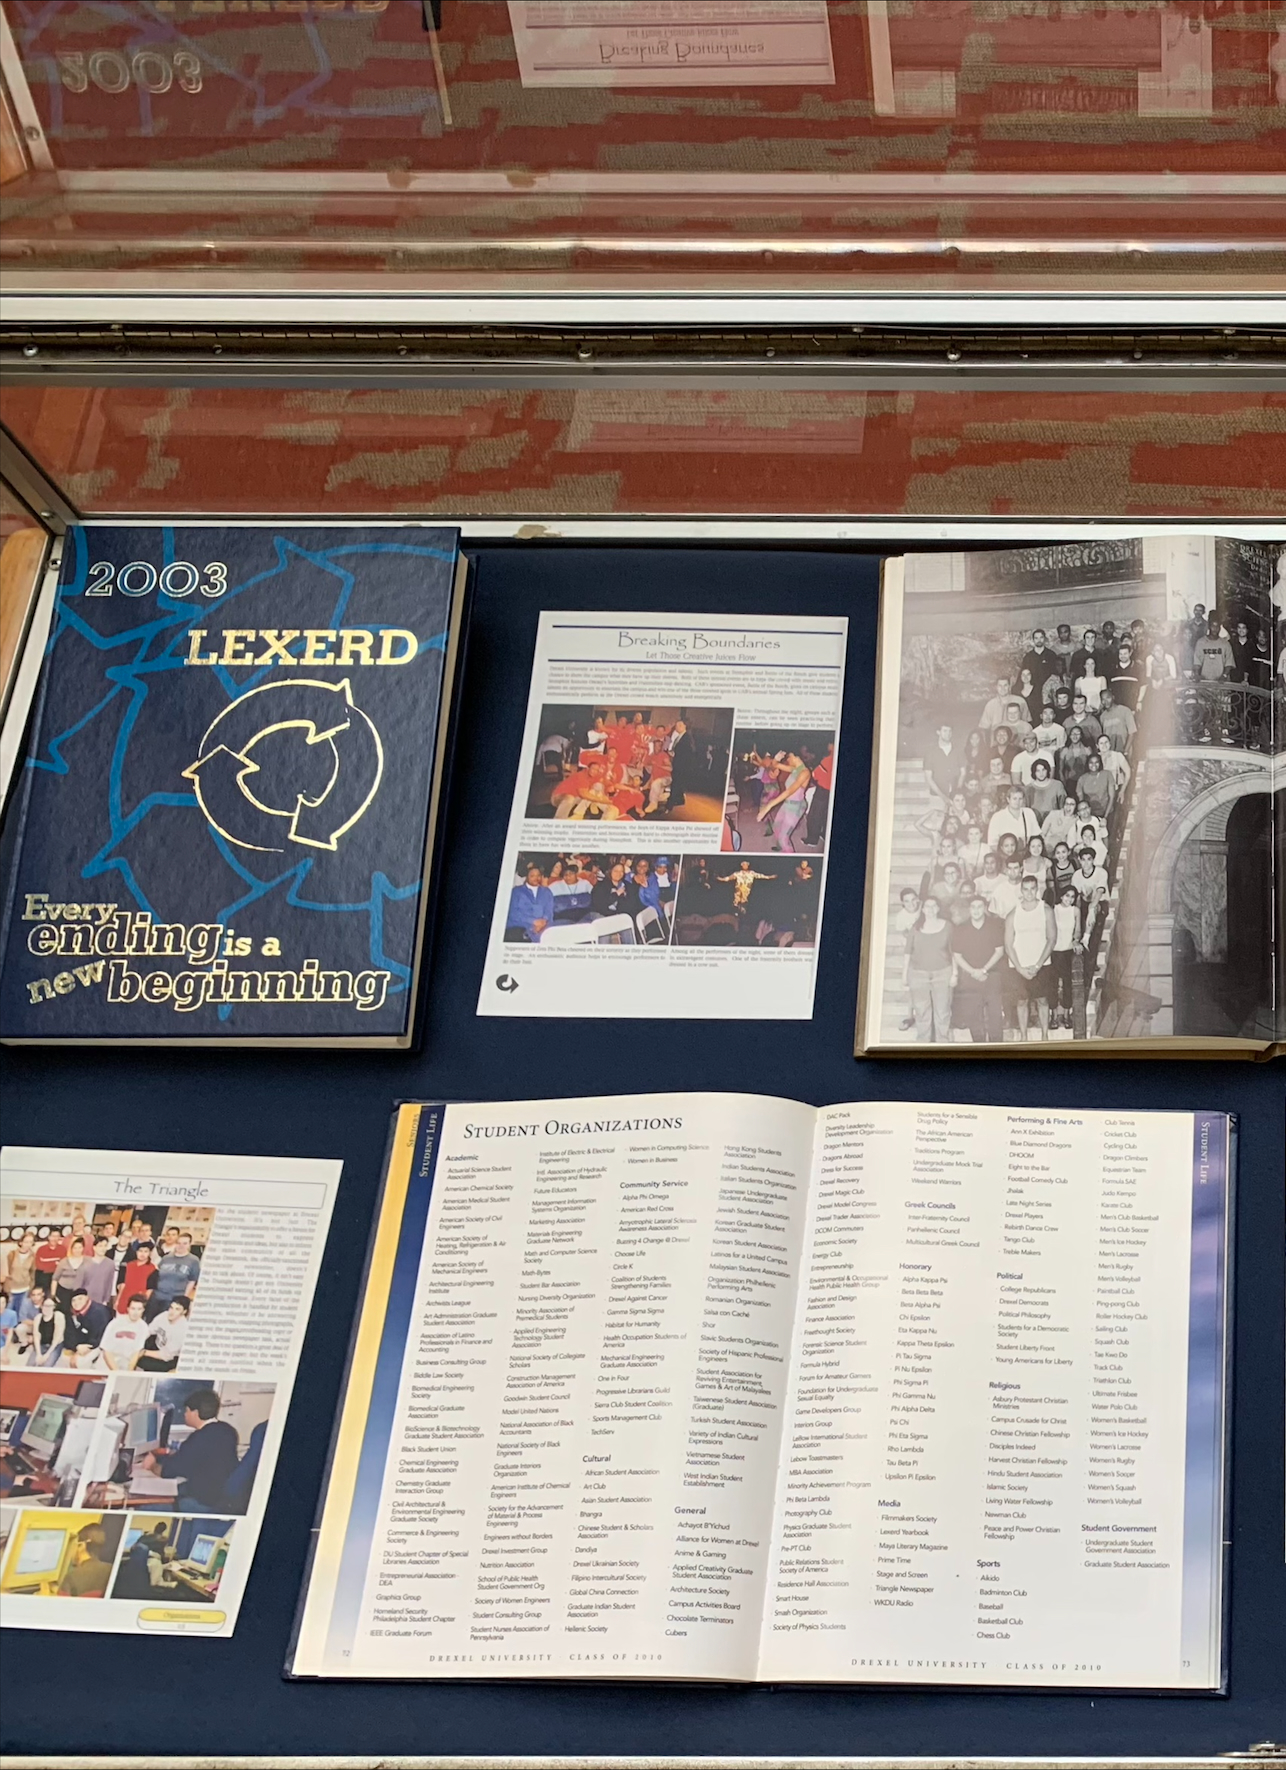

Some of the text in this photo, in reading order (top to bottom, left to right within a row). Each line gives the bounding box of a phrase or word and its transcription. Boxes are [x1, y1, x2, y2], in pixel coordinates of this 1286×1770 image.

[85, 561, 228, 597] 2003
[184, 629, 419, 666] LEXERD
[617, 630, 781, 651] Breaking Boundaries
[645, 651, 756, 662] Let Those Creative Juices Flow
[22, 894, 117, 925] Every
[27, 912, 281, 964] ending is a
[26, 959, 390, 1011] new beginning
[464, 1118, 682, 1138] STUDENT ORGANIZATIONS
[1007, 1116, 1045, 1125] Performing
[419, 1112, 438, 1177] STUDENT LIFE
[1200, 1122, 1210, 1184] STUDENT LIFE
[114, 1179, 209, 1201] The Triangle
[619, 1181, 660, 1189] Community
[899, 1263, 932, 1271] Honorary
[989, 1382, 1020, 1390] Religious
[1082, 1524, 1109, 1532] Student
[977, 1559, 1000, 1568] Sports
[908, 1660, 986, 1668] UNIVERSITY
